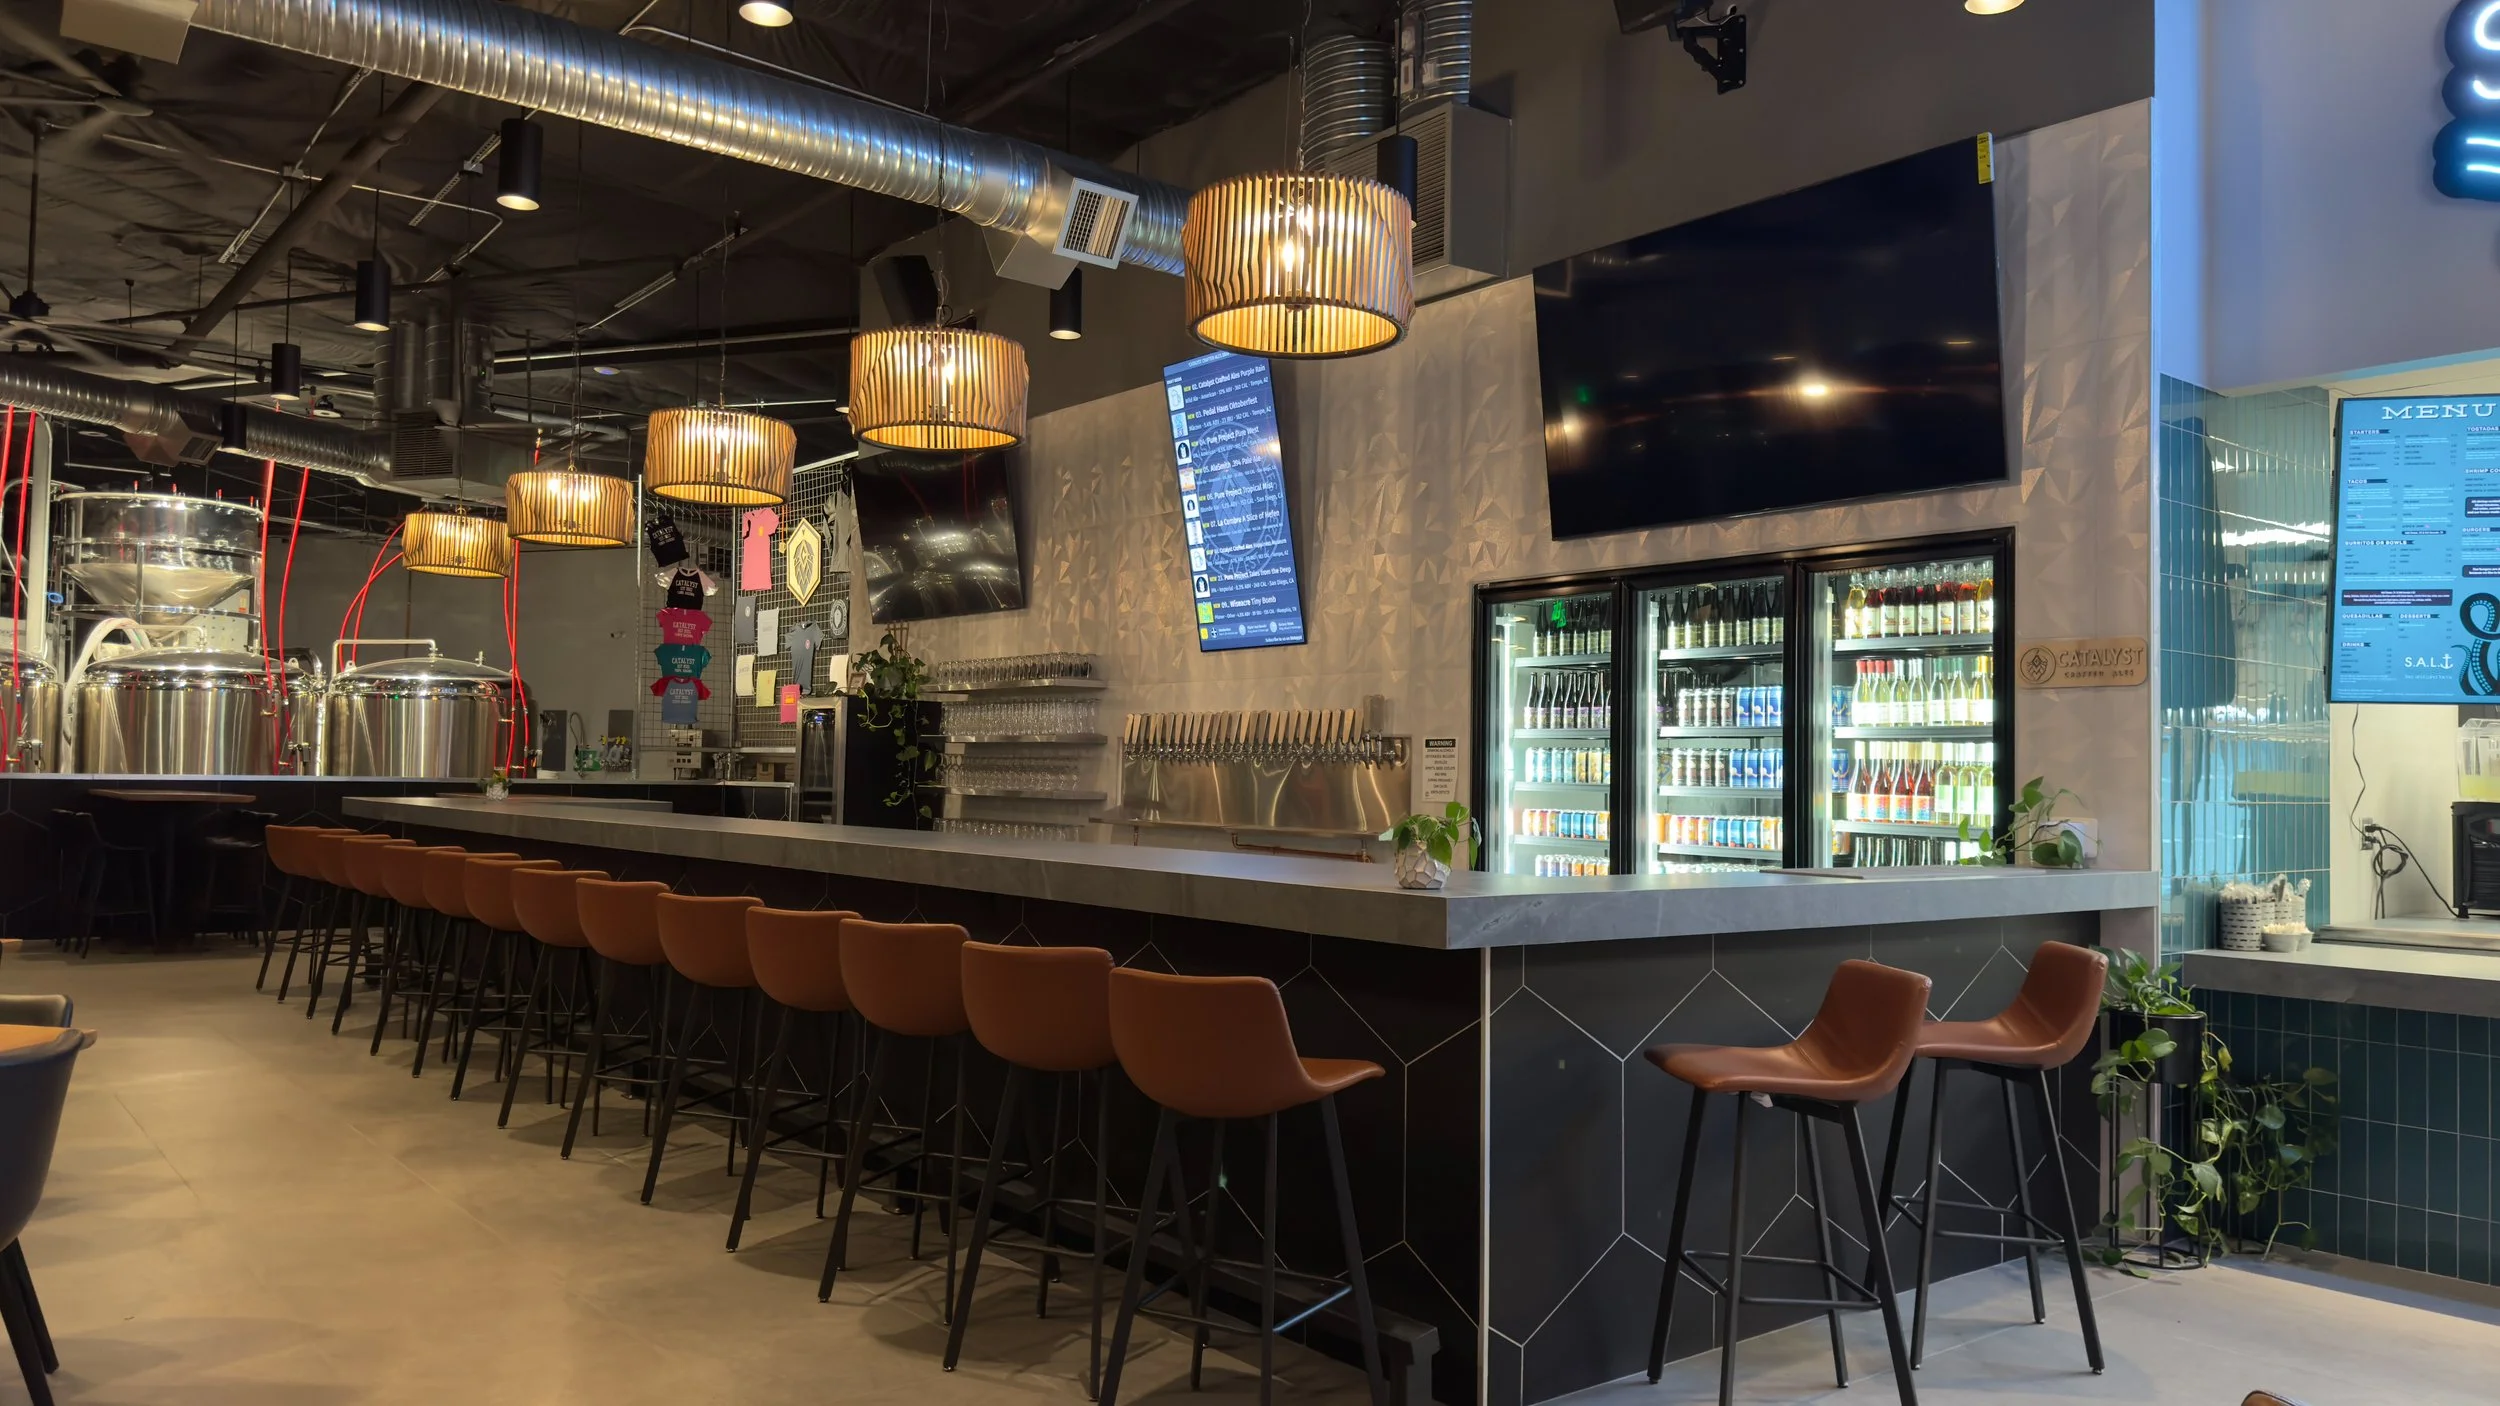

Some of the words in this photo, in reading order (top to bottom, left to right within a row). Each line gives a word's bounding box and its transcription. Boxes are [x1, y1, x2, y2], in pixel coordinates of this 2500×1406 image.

[1198, 379, 1215, 388] Catalyst
[1215, 374, 1230, 384] Crafted
[1241, 368, 1254, 376] Purple
[1203, 407, 1216, 416] Pedal
[1217, 405, 1229, 413] Haus
[1229, 397, 1258, 409] Oktoberfest
[2382, 403, 2496, 420] MENU
[1218, 432, 1234, 441] Project
[1211, 462, 1231, 472] AleSmith
[1226, 488, 1242, 497] Project
[1243, 483, 1261, 493] Tropical
[1224, 517, 1241, 525] Cumbre
[1234, 572, 1249, 580] Project
[676, 580, 698, 588] CATALYST
[1251, 597, 1261, 606] Tiny
[1262, 596, 1276, 604] Bomb
[673, 622, 696, 630] CATALYST
[2060, 647, 2144, 667] CATALYST
